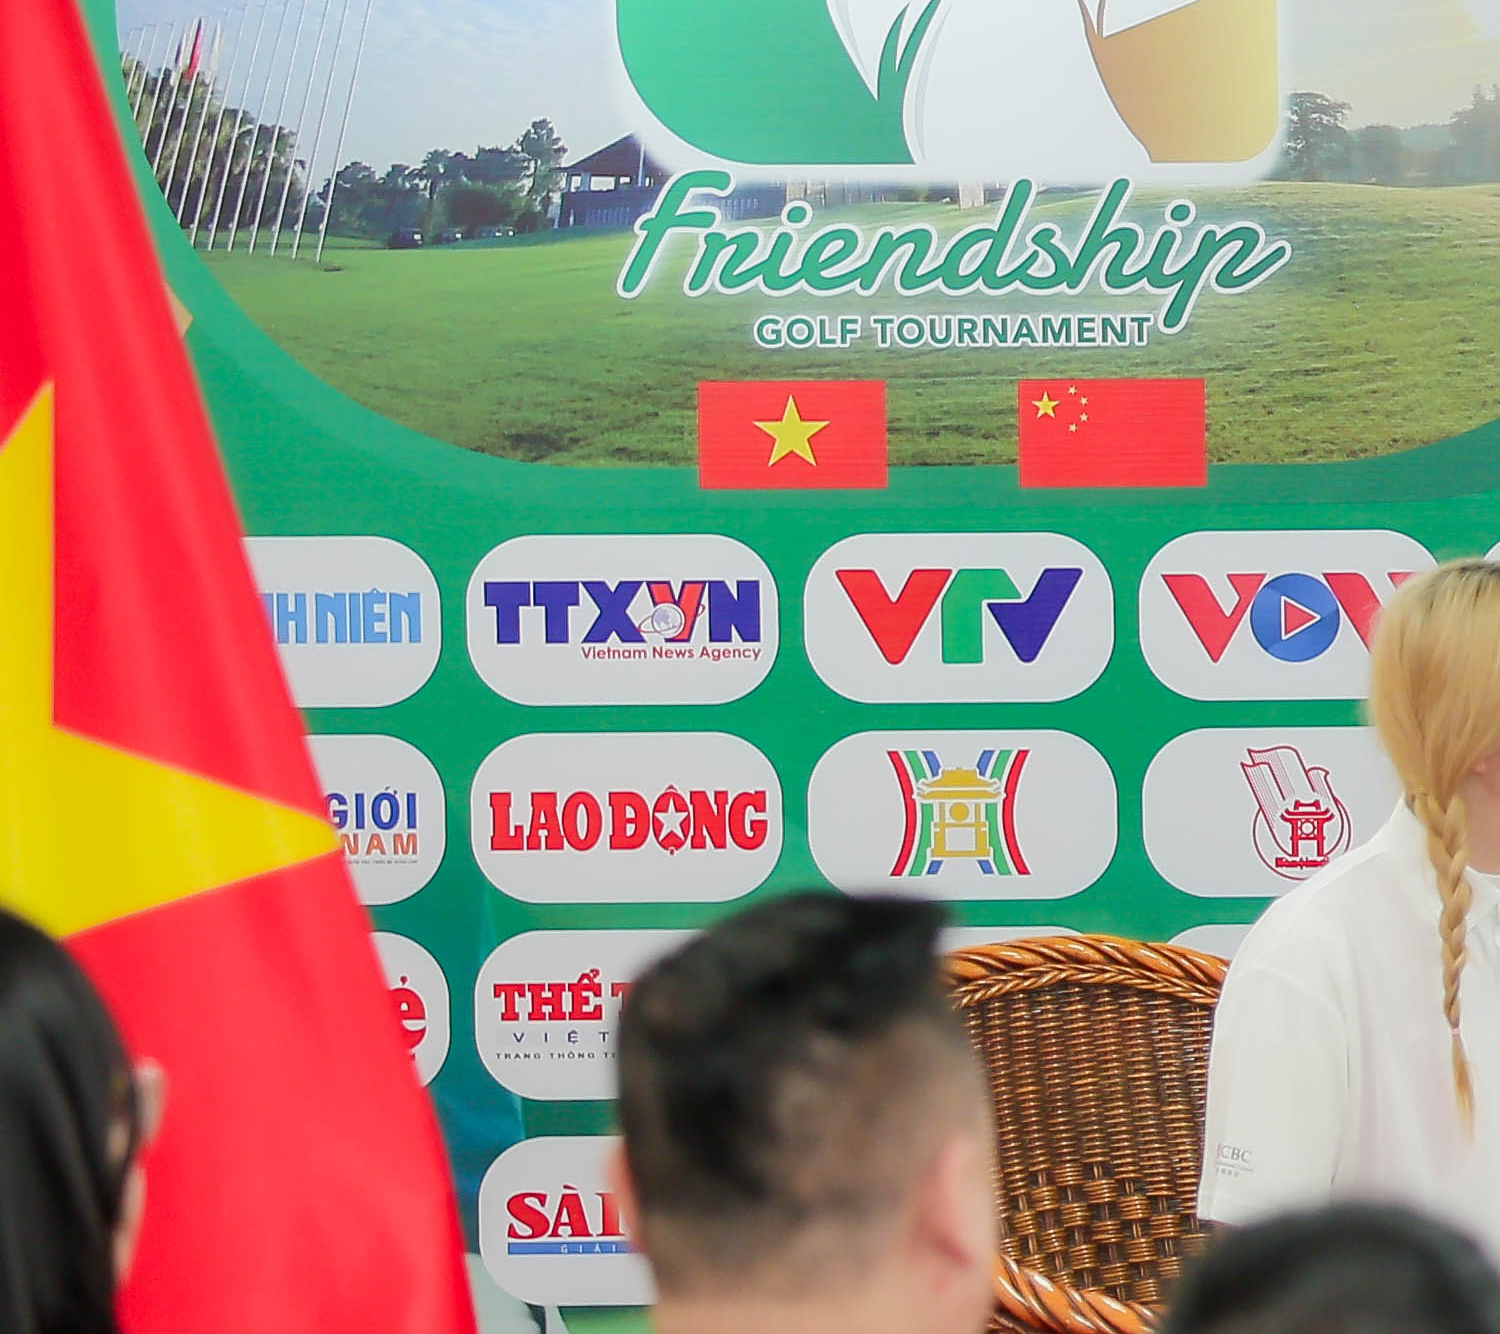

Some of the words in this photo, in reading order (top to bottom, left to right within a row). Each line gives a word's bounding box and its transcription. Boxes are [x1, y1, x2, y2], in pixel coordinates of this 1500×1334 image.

[620, 170, 1290, 330] Friendship
[756, 316, 861, 347] GOLF
[876, 315, 1152, 346] TOURNAMENT
[314, 588, 422, 645] NIÊN
[483, 579, 762, 645] TTXVN
[835, 567, 1083, 665] VTV
[581, 645, 648, 661] Vietnam
[652, 645, 696, 660] News
[699, 645, 762, 663] Agency
[489, 790, 604, 853] LAO
[493, 967, 603, 1021] THỂ
[506, 1183, 626, 1240] SÀI
